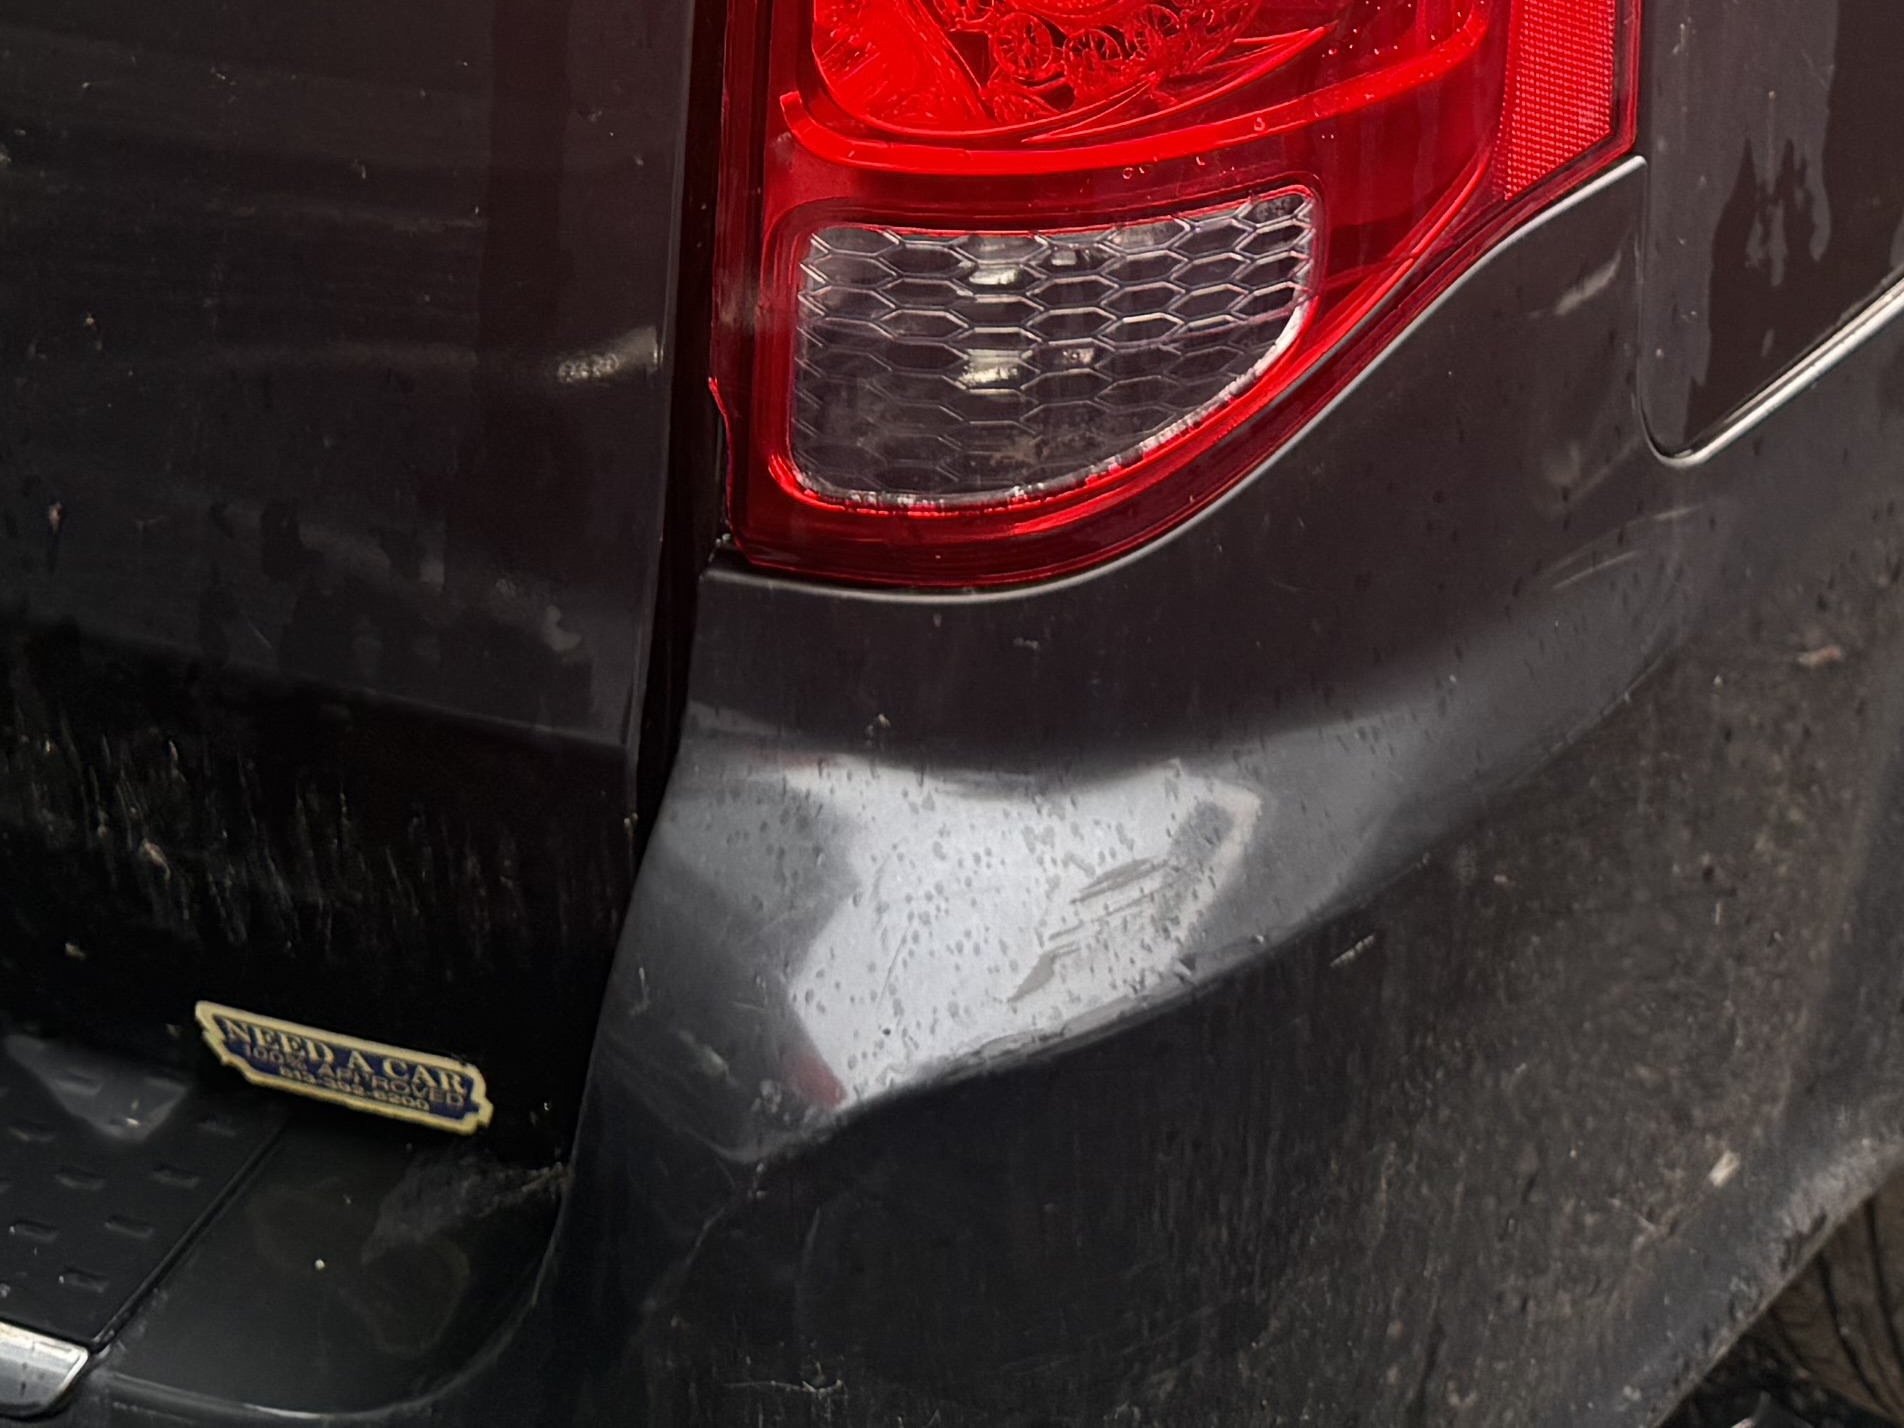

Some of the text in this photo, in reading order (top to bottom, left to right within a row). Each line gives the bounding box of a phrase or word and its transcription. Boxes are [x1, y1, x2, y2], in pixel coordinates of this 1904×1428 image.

[219, 1017, 468, 1095] NEED A CAR
[317, 1063, 466, 1108] APPROVED
